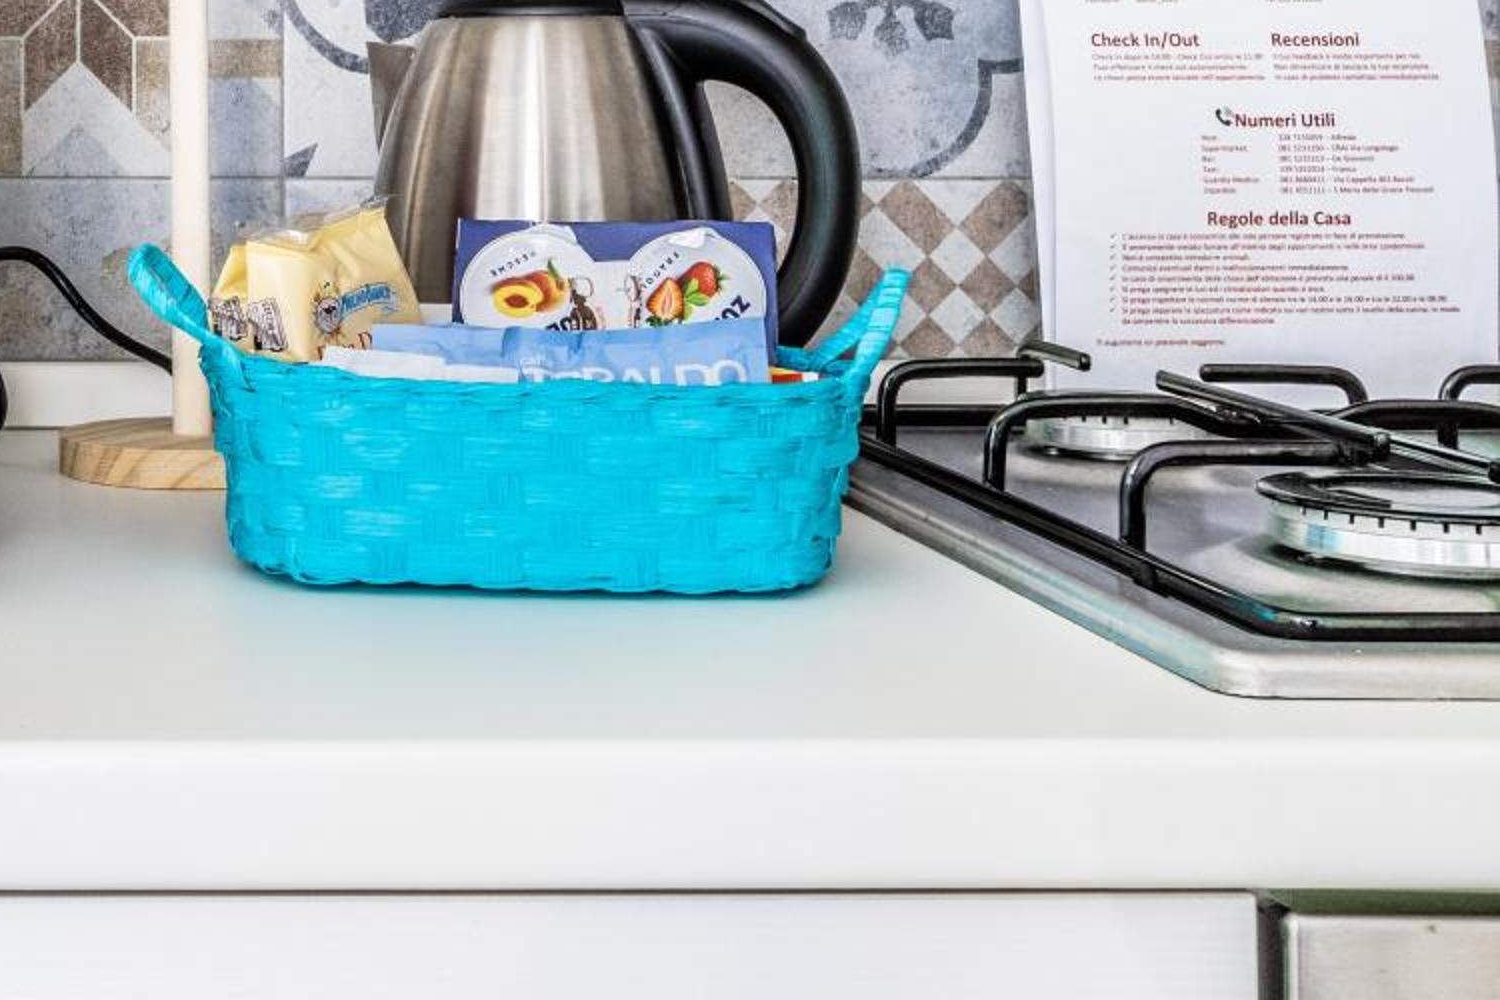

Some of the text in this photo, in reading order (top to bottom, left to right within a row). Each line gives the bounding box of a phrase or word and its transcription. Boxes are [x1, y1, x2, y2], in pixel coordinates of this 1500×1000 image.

[1091, 33, 1200, 49] Check In/Out
[1271, 32, 1360, 47] Recensioni
[1235, 112, 1336, 127] Numeri Utili
[1207, 211, 1351, 228] Regole della Casa
